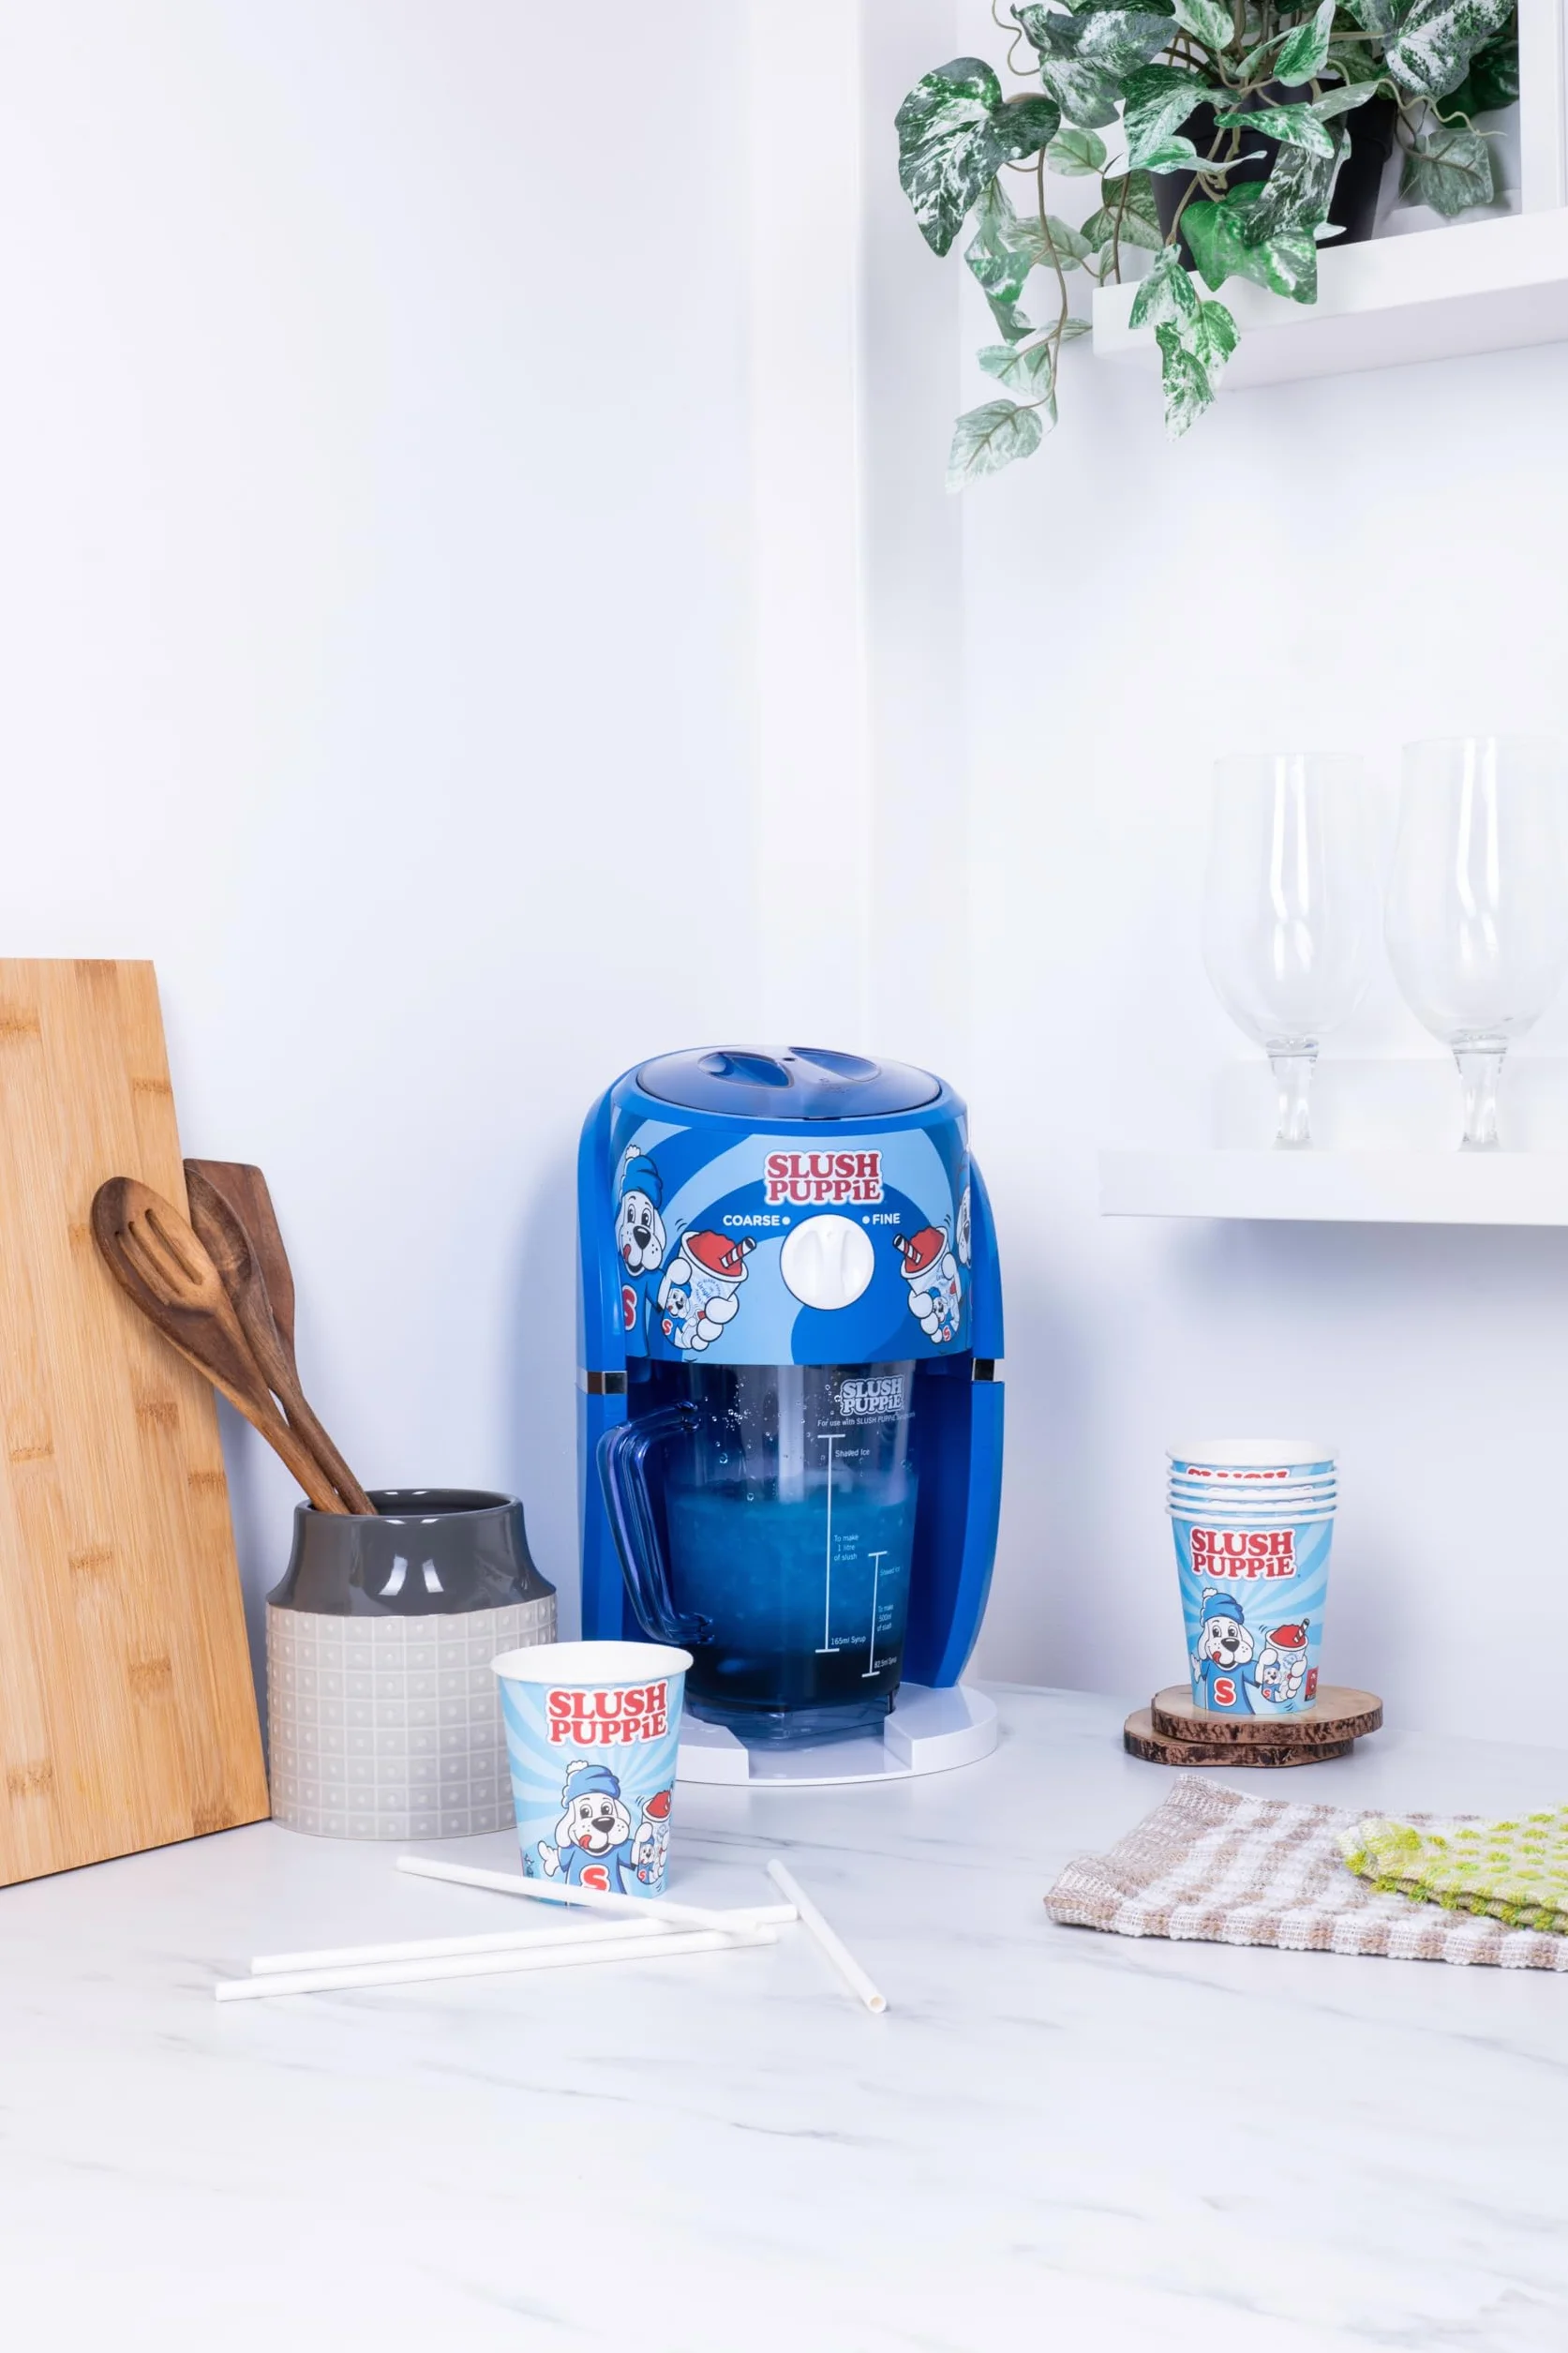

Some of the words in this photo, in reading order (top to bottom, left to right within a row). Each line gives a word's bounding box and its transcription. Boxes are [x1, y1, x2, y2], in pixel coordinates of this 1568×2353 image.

[768, 1153, 879, 1178] SLUSH
[723, 1215, 780, 1226] COARSE
[873, 1213, 901, 1224] FINE
[842, 1377, 903, 1398] SLUSH
[856, 1416, 876, 1425] SLUSH
[835, 1449, 859, 1458] Shaved
[1191, 1528, 1293, 1557] SLUSH
[834, 1553, 842, 1562] of
[842, 1552, 858, 1561] slush
[830, 1637, 850, 1645] 165ml
[850, 1634, 867, 1645] Syrup
[1215, 1679, 1236, 1705] S
[548, 1683, 667, 1719] SLUSH
[582, 1866, 608, 1890] S
